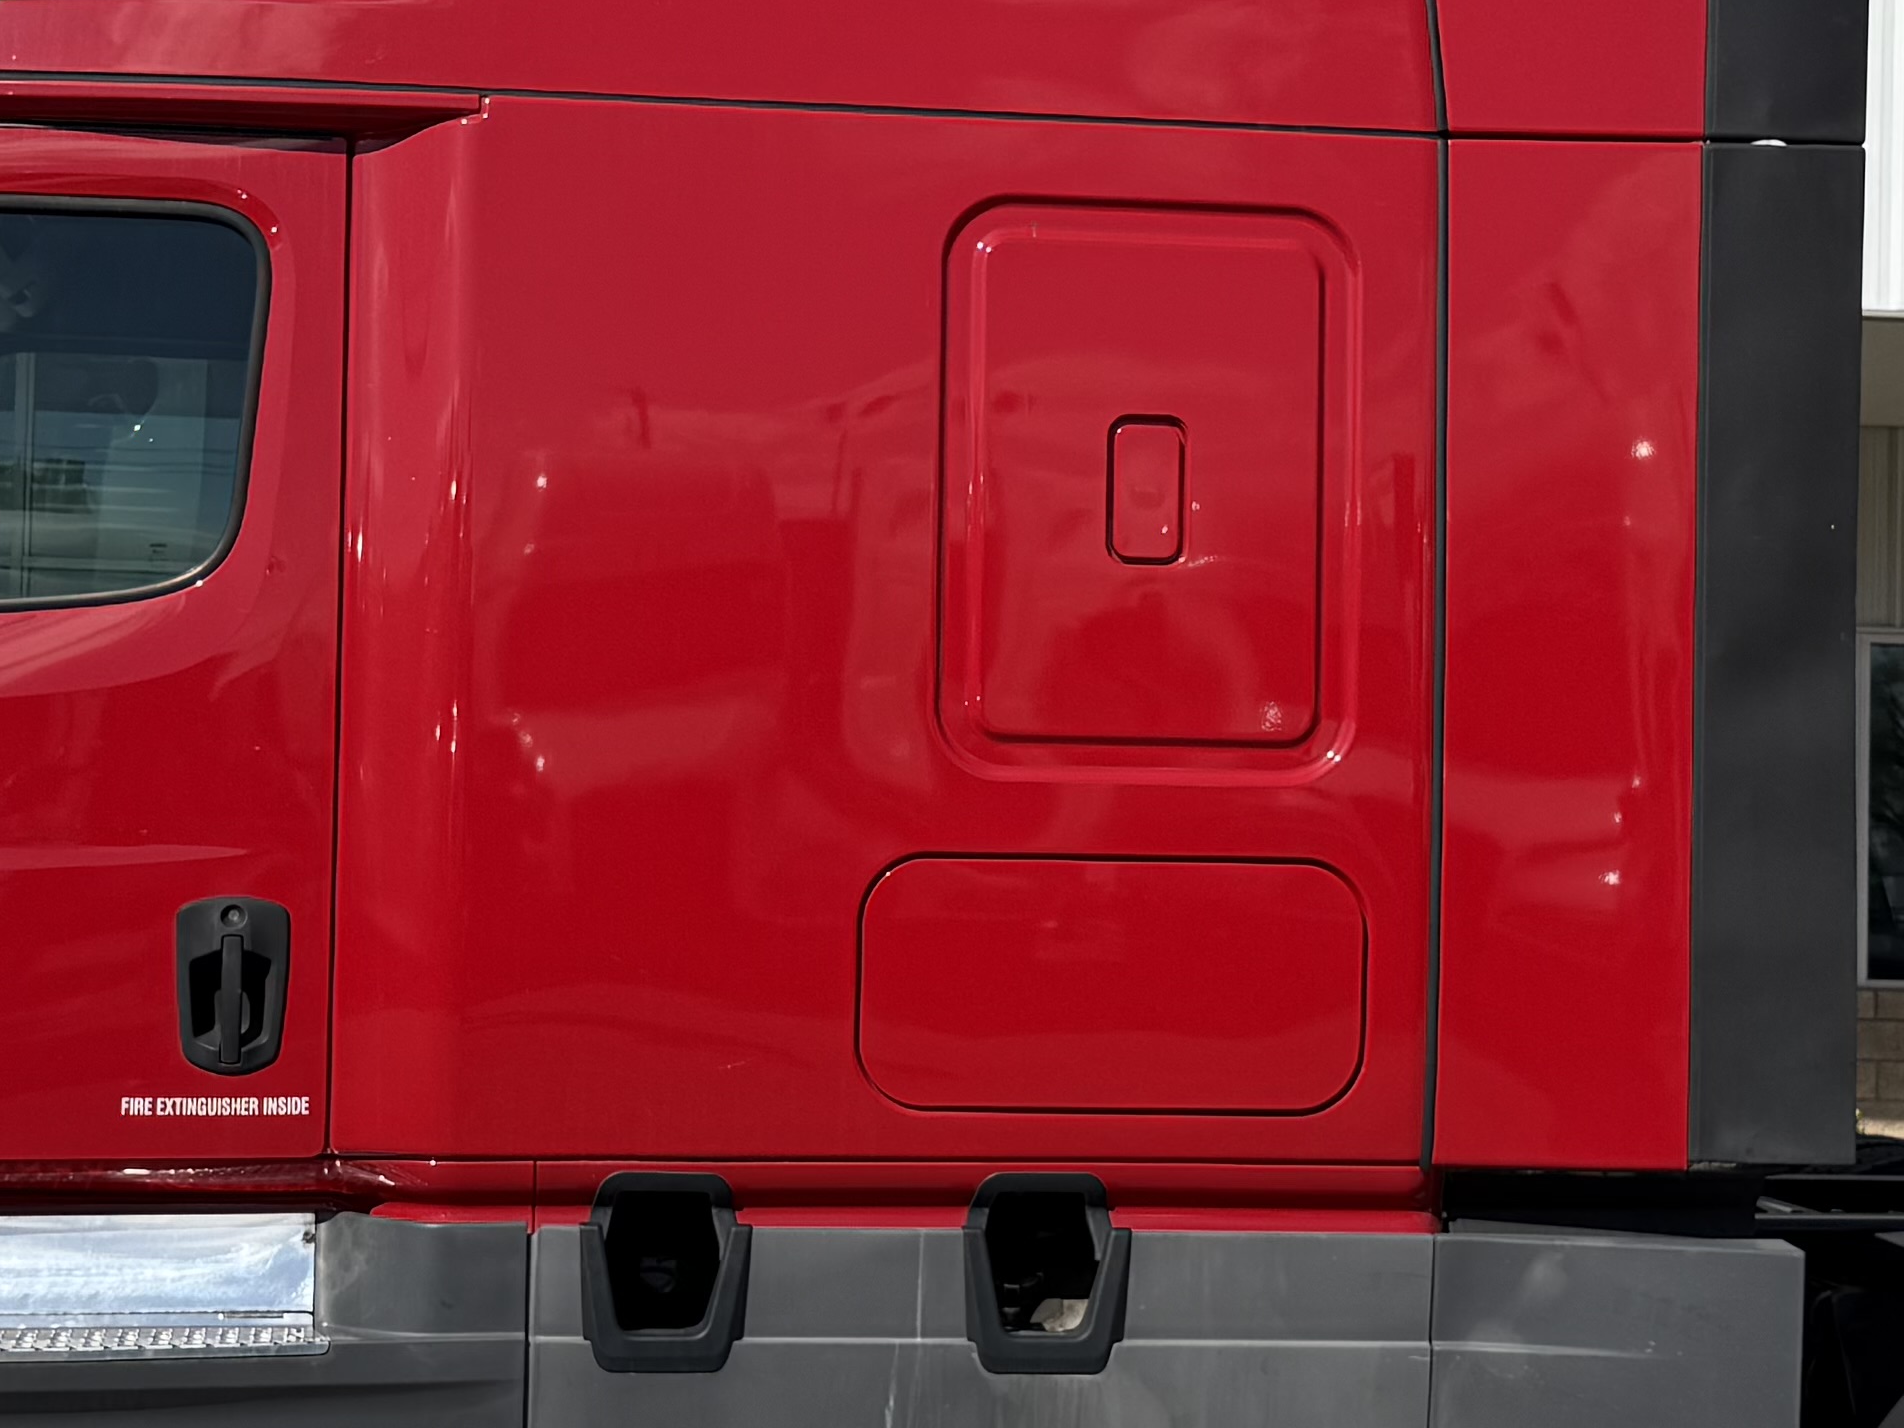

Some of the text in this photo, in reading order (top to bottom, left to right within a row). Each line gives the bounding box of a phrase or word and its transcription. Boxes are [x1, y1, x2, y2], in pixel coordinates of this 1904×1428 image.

[121, 1096, 310, 1117] FIRE EXTINGUISHER INSIDE
